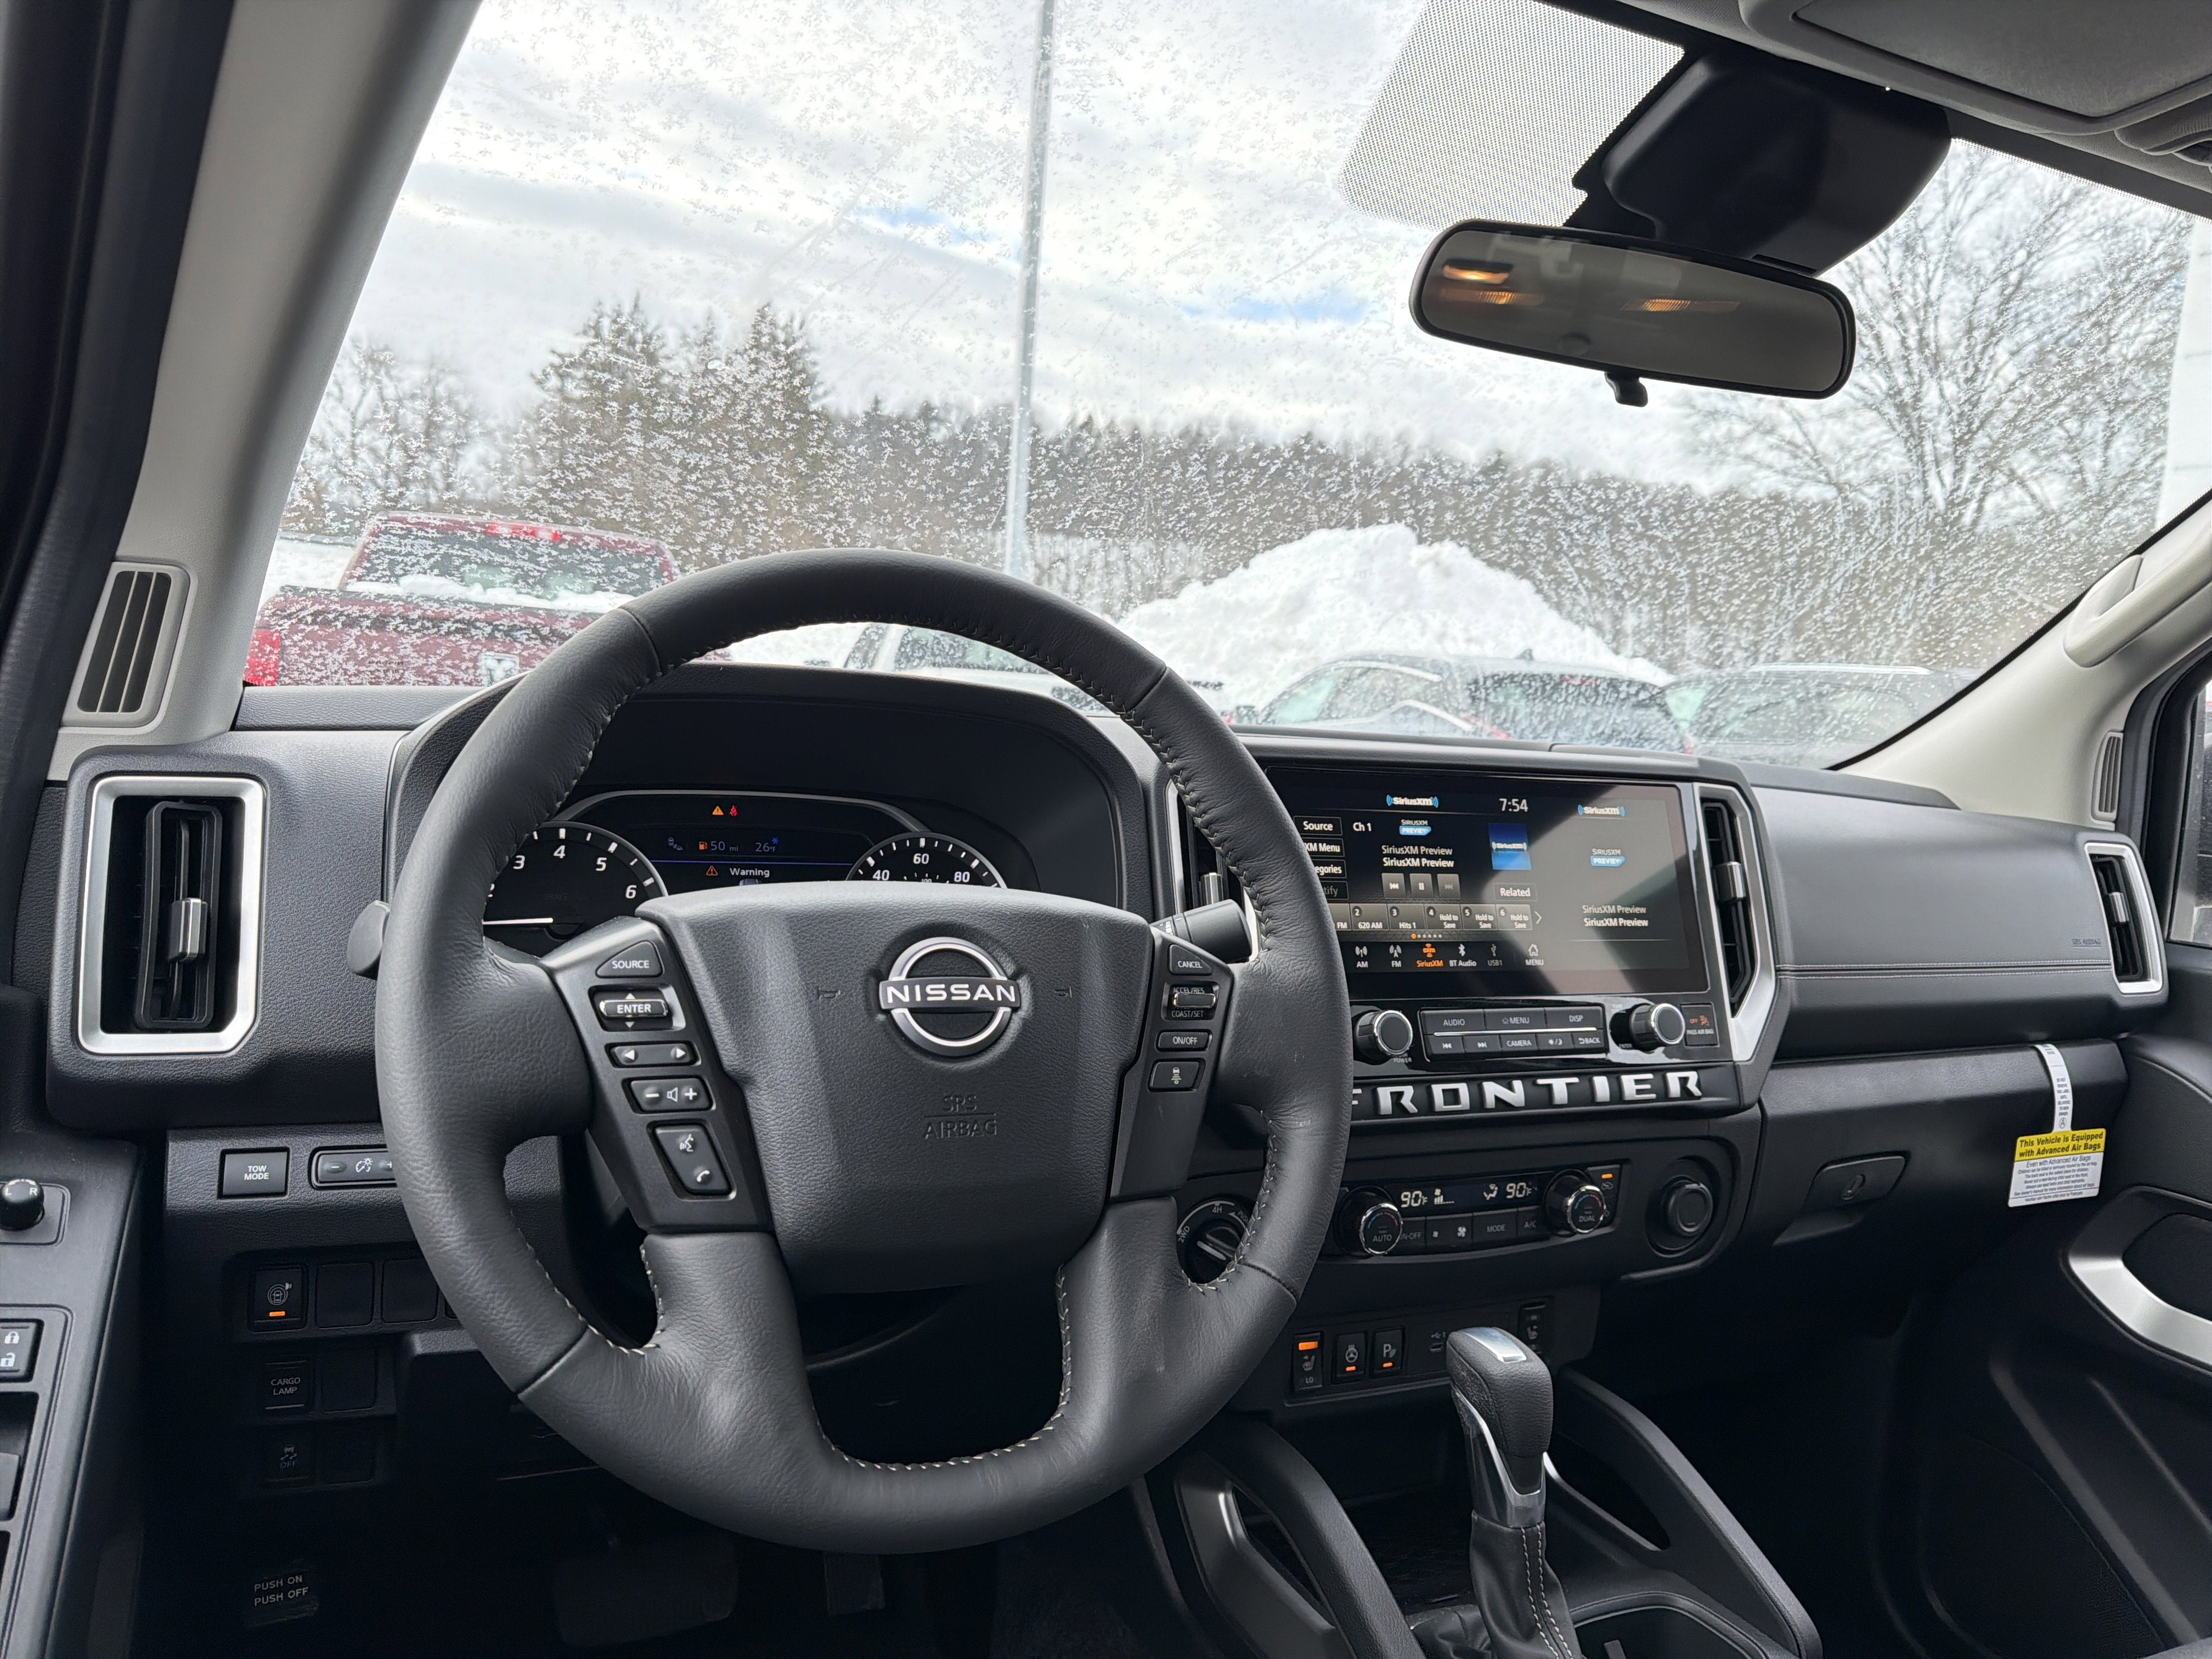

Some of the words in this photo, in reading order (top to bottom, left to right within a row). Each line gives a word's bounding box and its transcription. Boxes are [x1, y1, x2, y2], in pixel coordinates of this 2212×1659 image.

[1499, 798, 1528, 812] 7:54
[1303, 821, 1333, 832] Source
[1353, 822, 1365, 832] Ch
[1367, 822, 1372, 832] 1
[710, 841, 726, 851] 50
[1319, 843, 1340, 852] Menu
[1381, 845, 1419, 855] SiriusXM
[1420, 846, 1453, 855] Preview
[553, 845, 566, 859] 4
[513, 855, 526, 870] 3
[596, 857, 607, 871] 5
[913, 853, 929, 865] 60
[1383, 857, 1420, 867] SiriusXM
[1421, 857, 1454, 867] Preview
[729, 868, 770, 878] Warning
[872, 870, 890, 881] 40
[1315, 865, 1342, 876] egories
[953, 871, 970, 883] 80
[625, 885, 637, 899] 6
[1500, 887, 1531, 897] Related
[1582, 905, 1616, 914] SiriusXM
[1617, 905, 1646, 914] Preview
[1584, 918, 1618, 927] SiriusXM
[1619, 918, 1649, 927] Preview
[612, 961, 650, 969] SOURCE
[1177, 961, 1203, 969] CANCEL
[887, 984, 1015, 1003] NISSAN
[617, 1003, 652, 1014] ENTER
[1443, 1018, 1465, 1026] AUDIO
[1172, 1036, 1198, 1045] ON/OFF
[942, 1095, 978, 1113] SRS
[924, 1119, 997, 1139] AIRBAG
[2019, 1139, 2035, 1148] This
[2036, 1137, 2061, 1146] Vehicle
[2071, 1131, 2103, 1142] Equipped
[2019, 1149, 2034, 1158] with
[2036, 1144, 2070, 1156] Advanced
[2071, 1143, 2082, 1152] Air
[2084, 1142, 2101, 1151] Bags
[244, 1172, 269, 1181] MODE
[5, 1188, 12, 1196] L
[29, 1187, 38, 1196] R
[1487, 1223, 1505, 1232] MODE
[1178, 1225, 1190, 1243] 2WD
[1372, 1234, 1392, 1243] AUTO
[270, 1377, 301, 1386] CARGO
[273, 1386, 297, 1395] LAMP
[254, 1578, 283, 1592] PUSH
[287, 1575, 303, 1584] ON
[254, 1592, 284, 1607] PUSH
[287, 1587, 309, 1599] OFF
